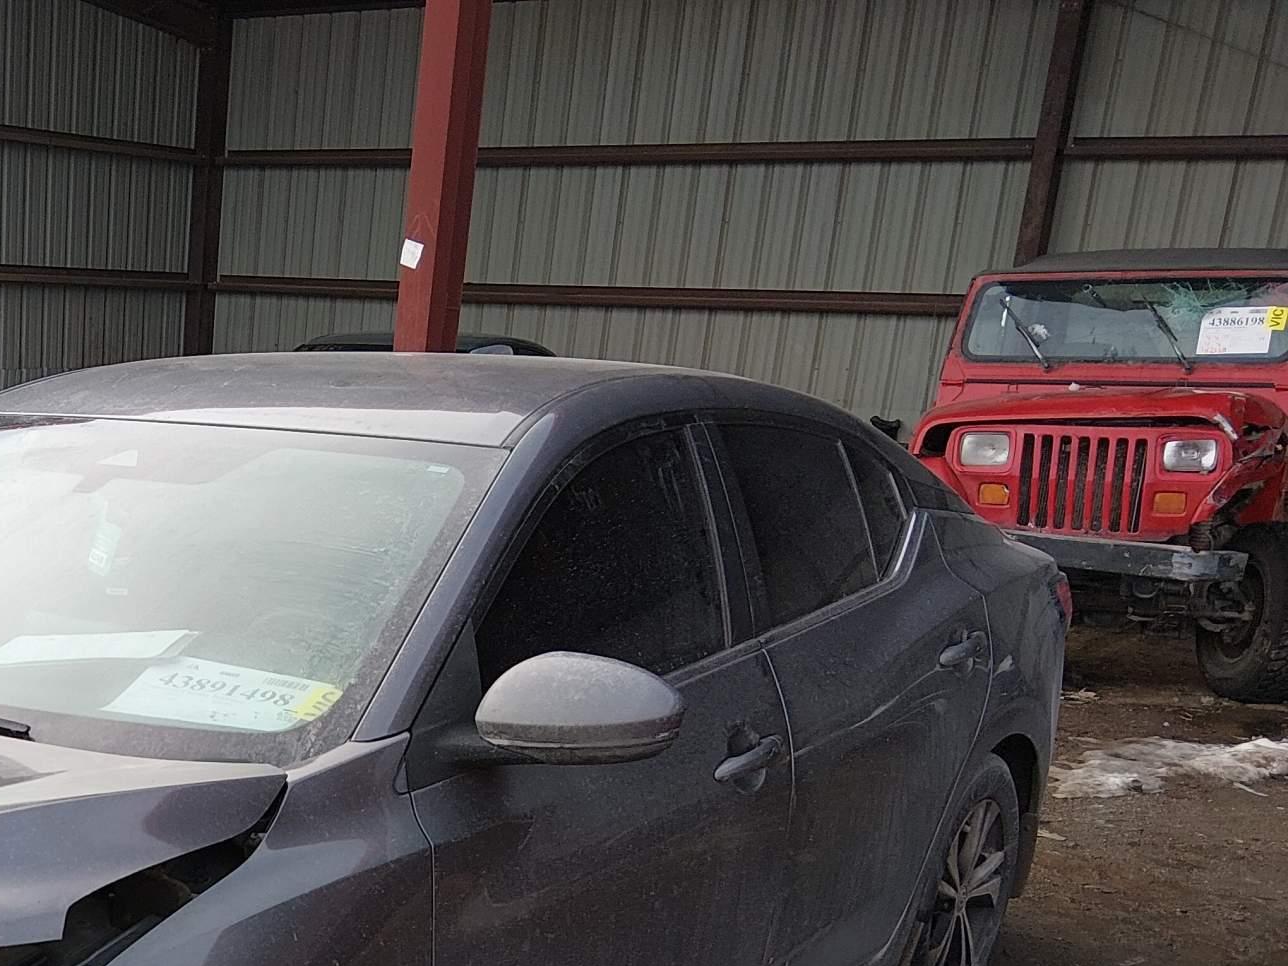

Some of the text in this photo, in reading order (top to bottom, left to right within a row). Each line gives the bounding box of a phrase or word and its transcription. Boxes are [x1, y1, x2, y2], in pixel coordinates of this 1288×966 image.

[1208, 317, 1265, 327] 43886198
[1269, 308, 1284, 328] VIC
[160, 672, 296, 707] 43891498
